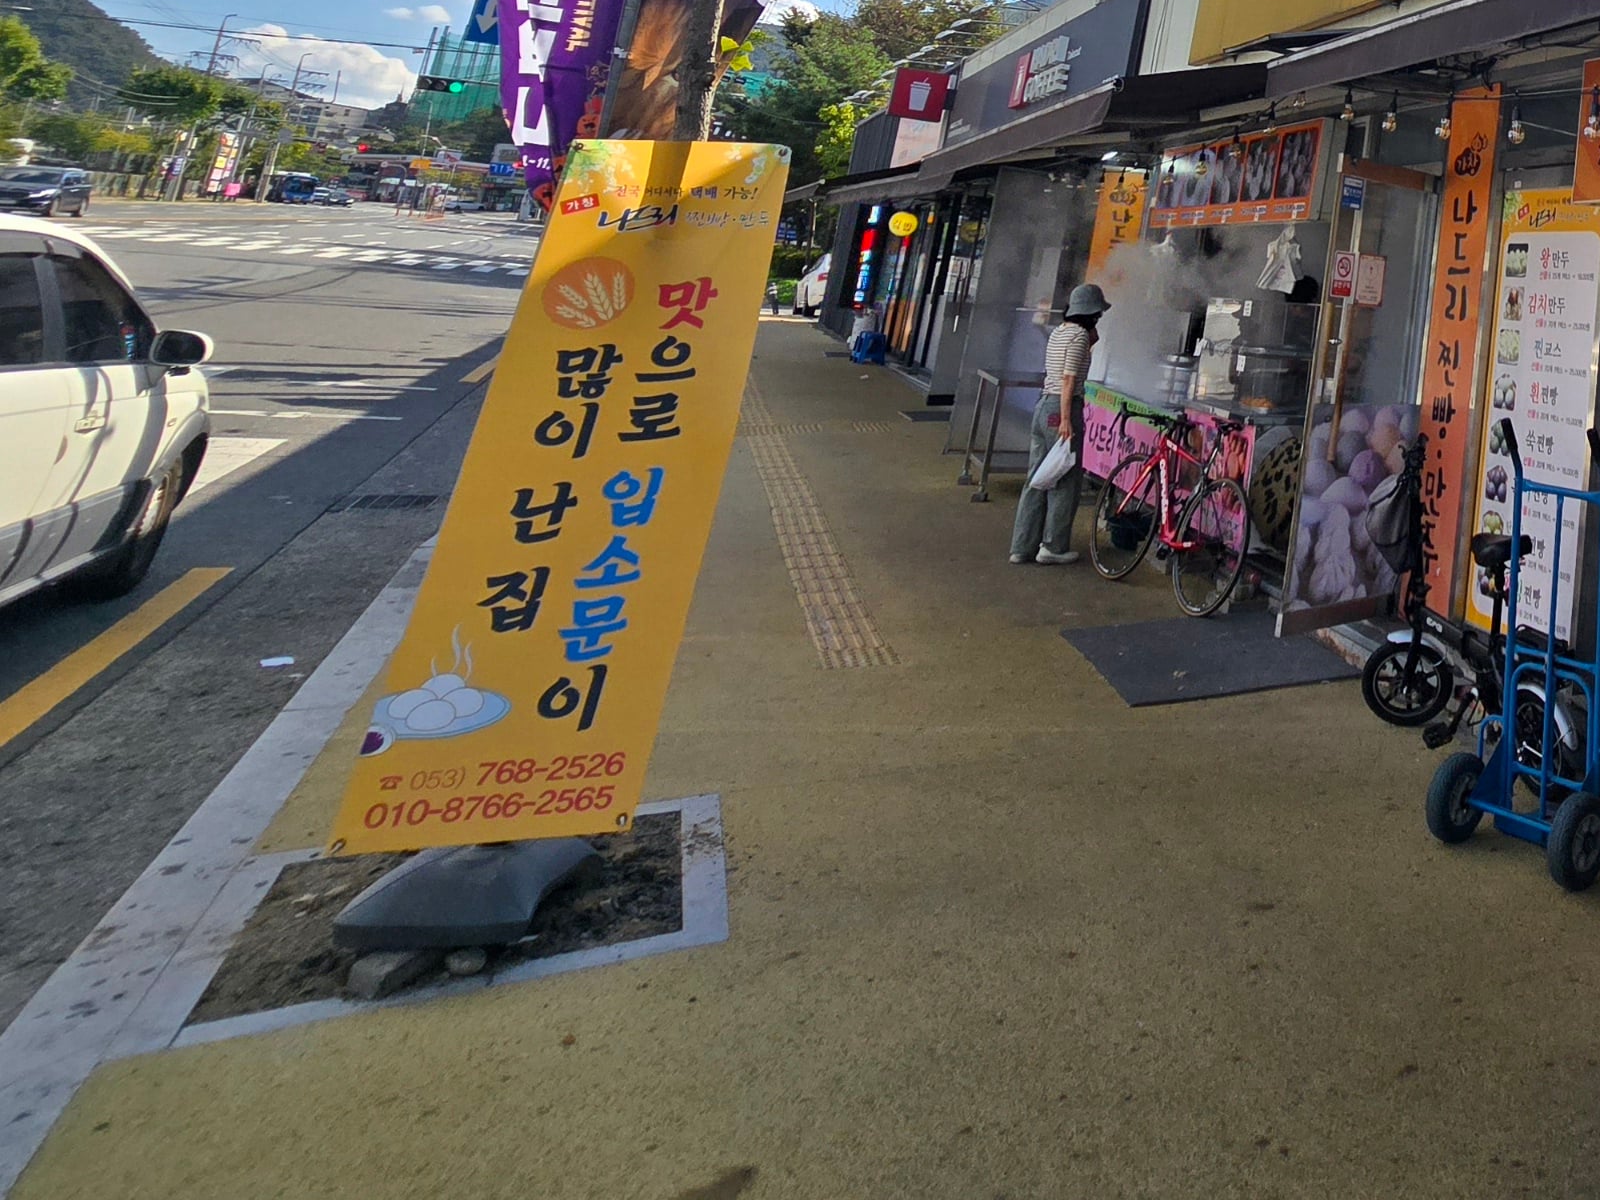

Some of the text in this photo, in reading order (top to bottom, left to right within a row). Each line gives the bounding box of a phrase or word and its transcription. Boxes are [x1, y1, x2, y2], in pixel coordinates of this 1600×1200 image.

[614, 185, 641, 198] 전국
[691, 186, 717, 199] 택배
[724, 185, 758, 200] 가능!
[566, 199, 595, 212] 가창
[1444, 189, 1478, 322] 나드리
[1540, 247, 1570, 270] 왕만두
[1528, 293, 1566, 315] 김치만두
[1534, 338, 1562, 359] 찐교스
[1530, 381, 1558, 406] 흰찐빵
[1525, 429, 1554, 455] 쑥찐빵
[475, 343, 624, 633] 많이 난 집
[537, 277, 719, 732] 맛으로 입소문이
[410, 751, 626, 791] 053) 768-2526
[364, 785, 614, 831] 010-8766-2565
